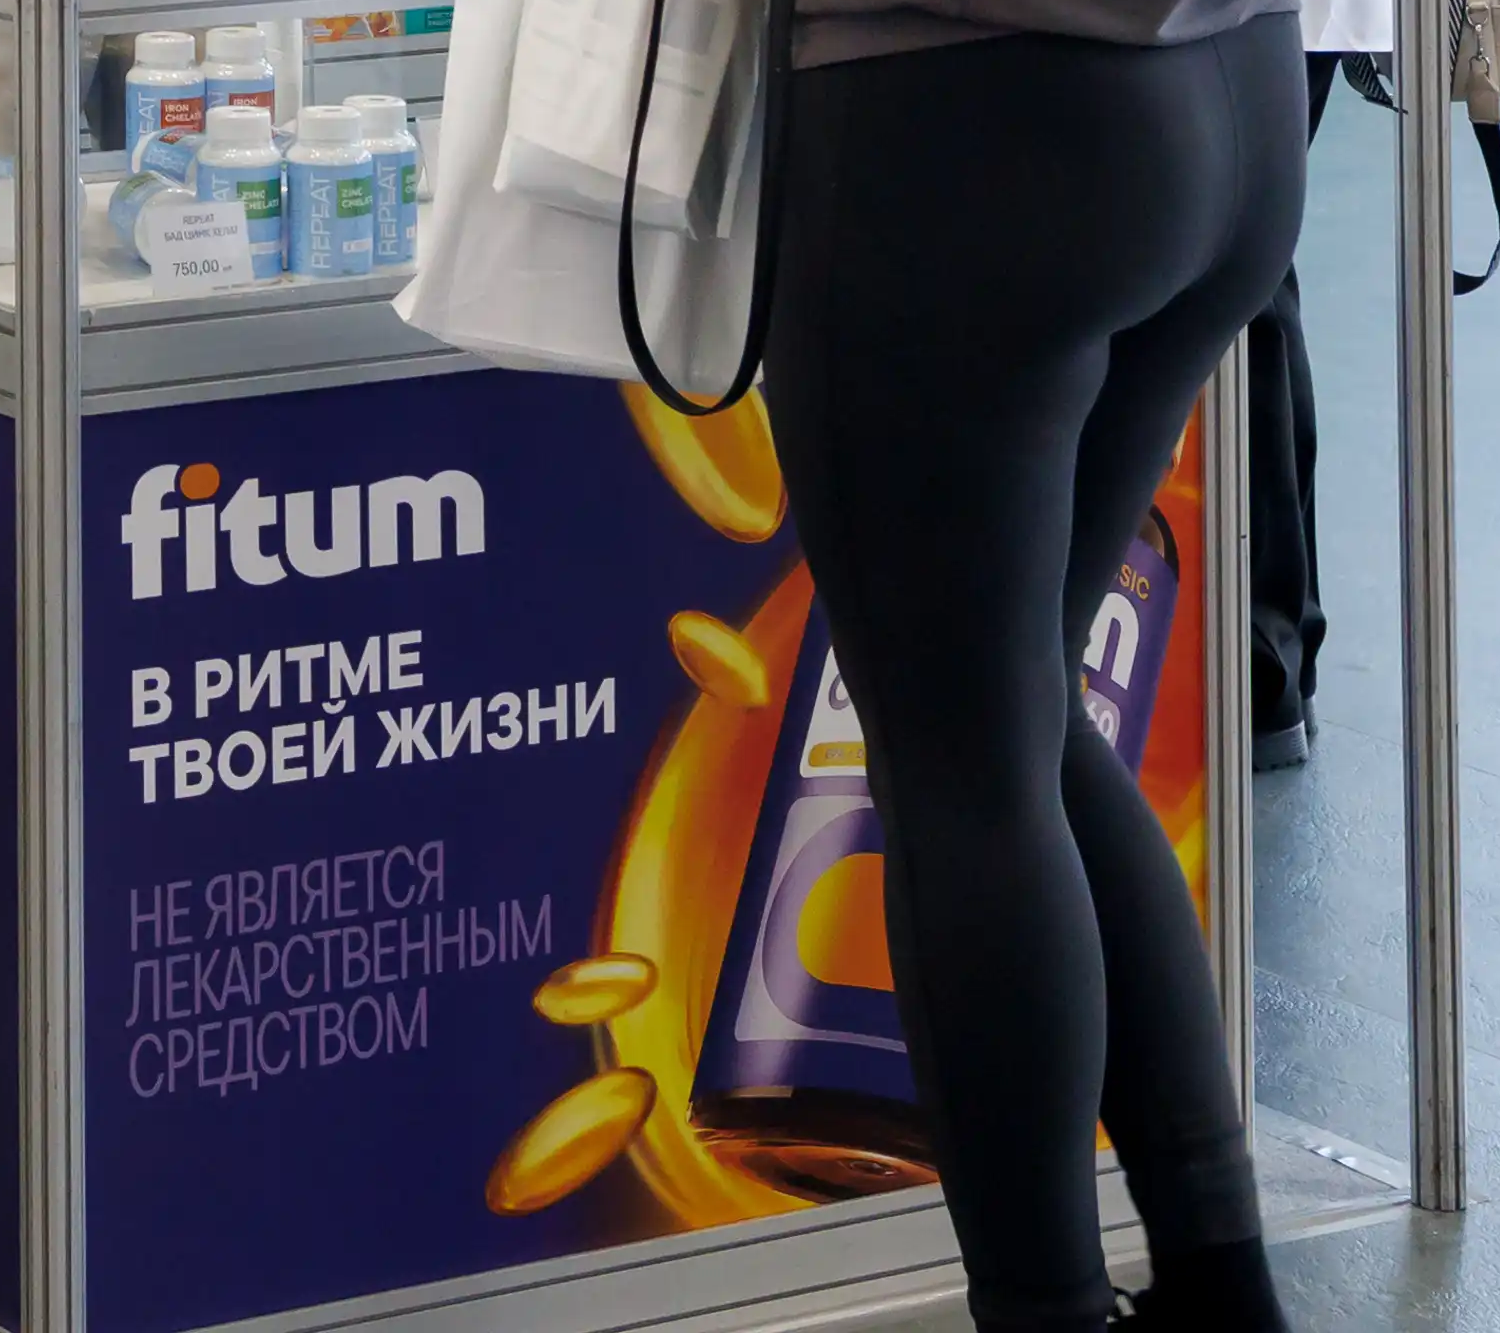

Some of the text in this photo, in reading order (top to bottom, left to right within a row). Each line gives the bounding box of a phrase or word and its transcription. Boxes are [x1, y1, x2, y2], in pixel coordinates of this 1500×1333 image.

[165, 104, 190, 112] IRON
[233, 97, 258, 106] IRON
[182, 213, 215, 225] REPEAT
[310, 172, 332, 269] REPEAT
[377, 161, 398, 255] REPEAT
[172, 258, 220, 277] 750,00
[121, 462, 486, 601] fitum
[131, 629, 424, 729] В РИТМЕ
[129, 677, 619, 804] ТВОЕЙ ЖИЗНИ
[129, 839, 445, 953] НЕ ЯВЛЯЕТСЯ
[124, 894, 553, 1028] ЛЕКАРСТВЕННЫМ
[128, 986, 430, 1101] СРЕДСТВОМ
